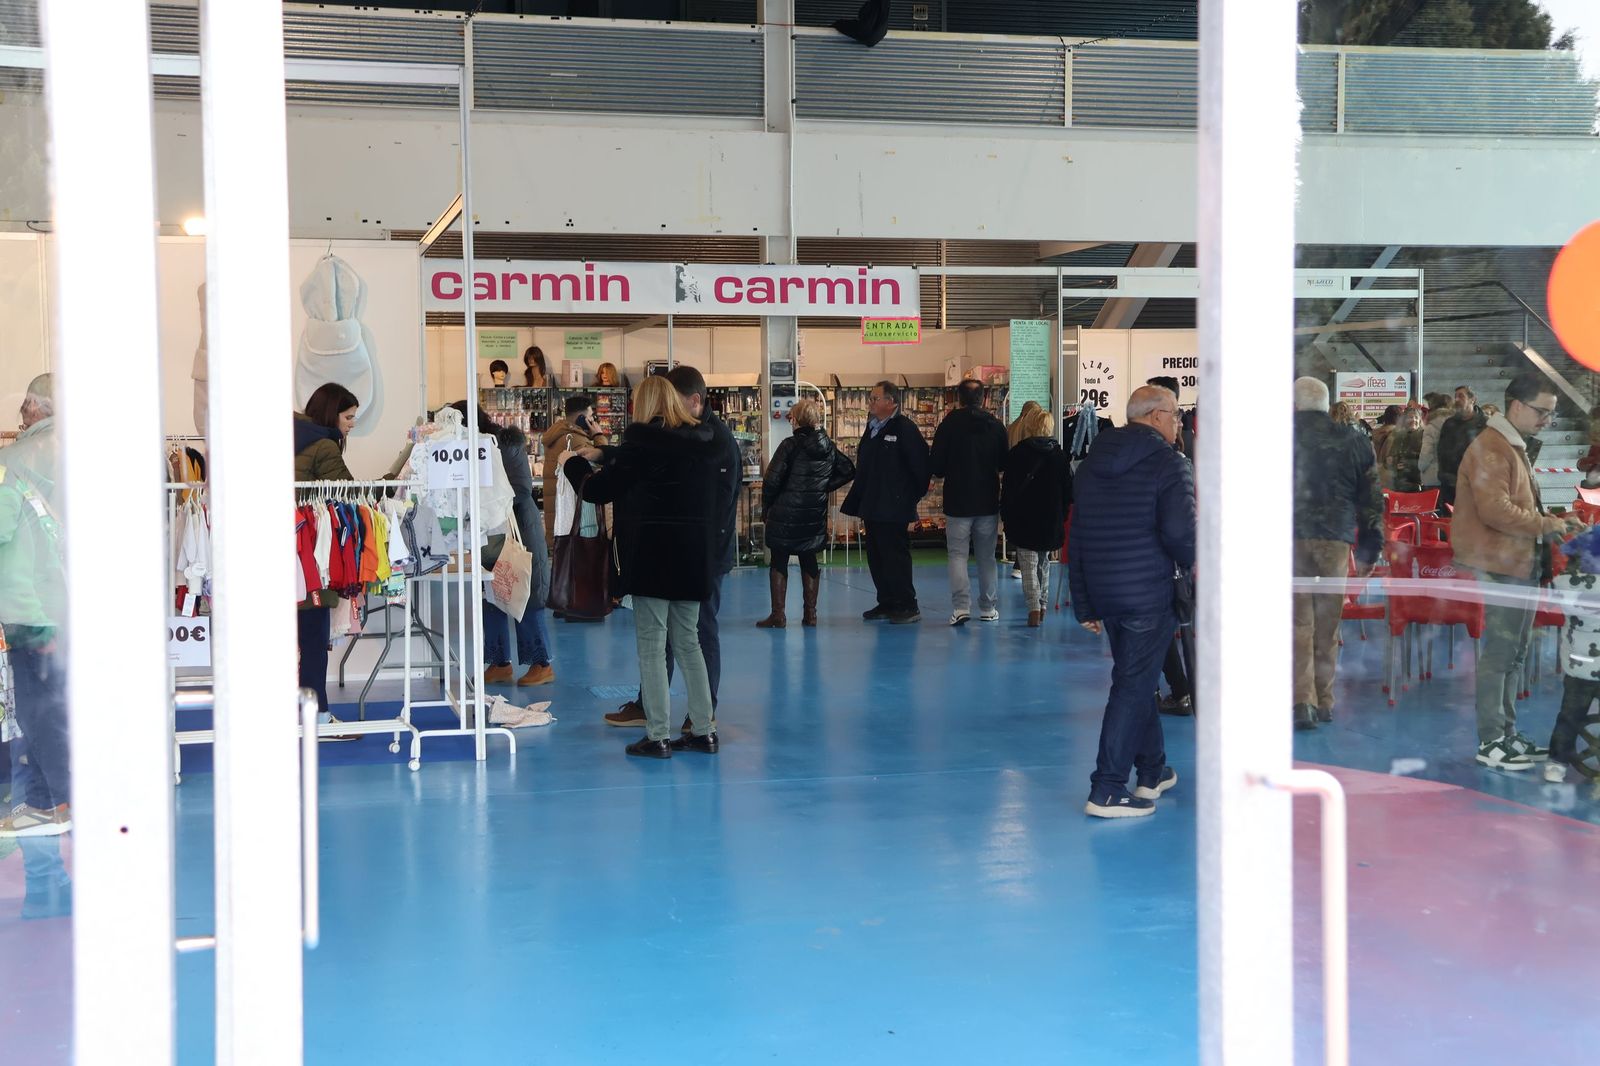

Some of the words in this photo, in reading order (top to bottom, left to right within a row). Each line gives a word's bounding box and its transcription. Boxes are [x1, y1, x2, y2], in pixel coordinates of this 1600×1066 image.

[431, 263, 630, 302] carmin
[714, 268, 901, 305] carmin
[1162, 357, 1199, 368] PRECIO
[1367, 376, 1387, 388] ifeza
[1080, 388, 1109, 408] 29€
